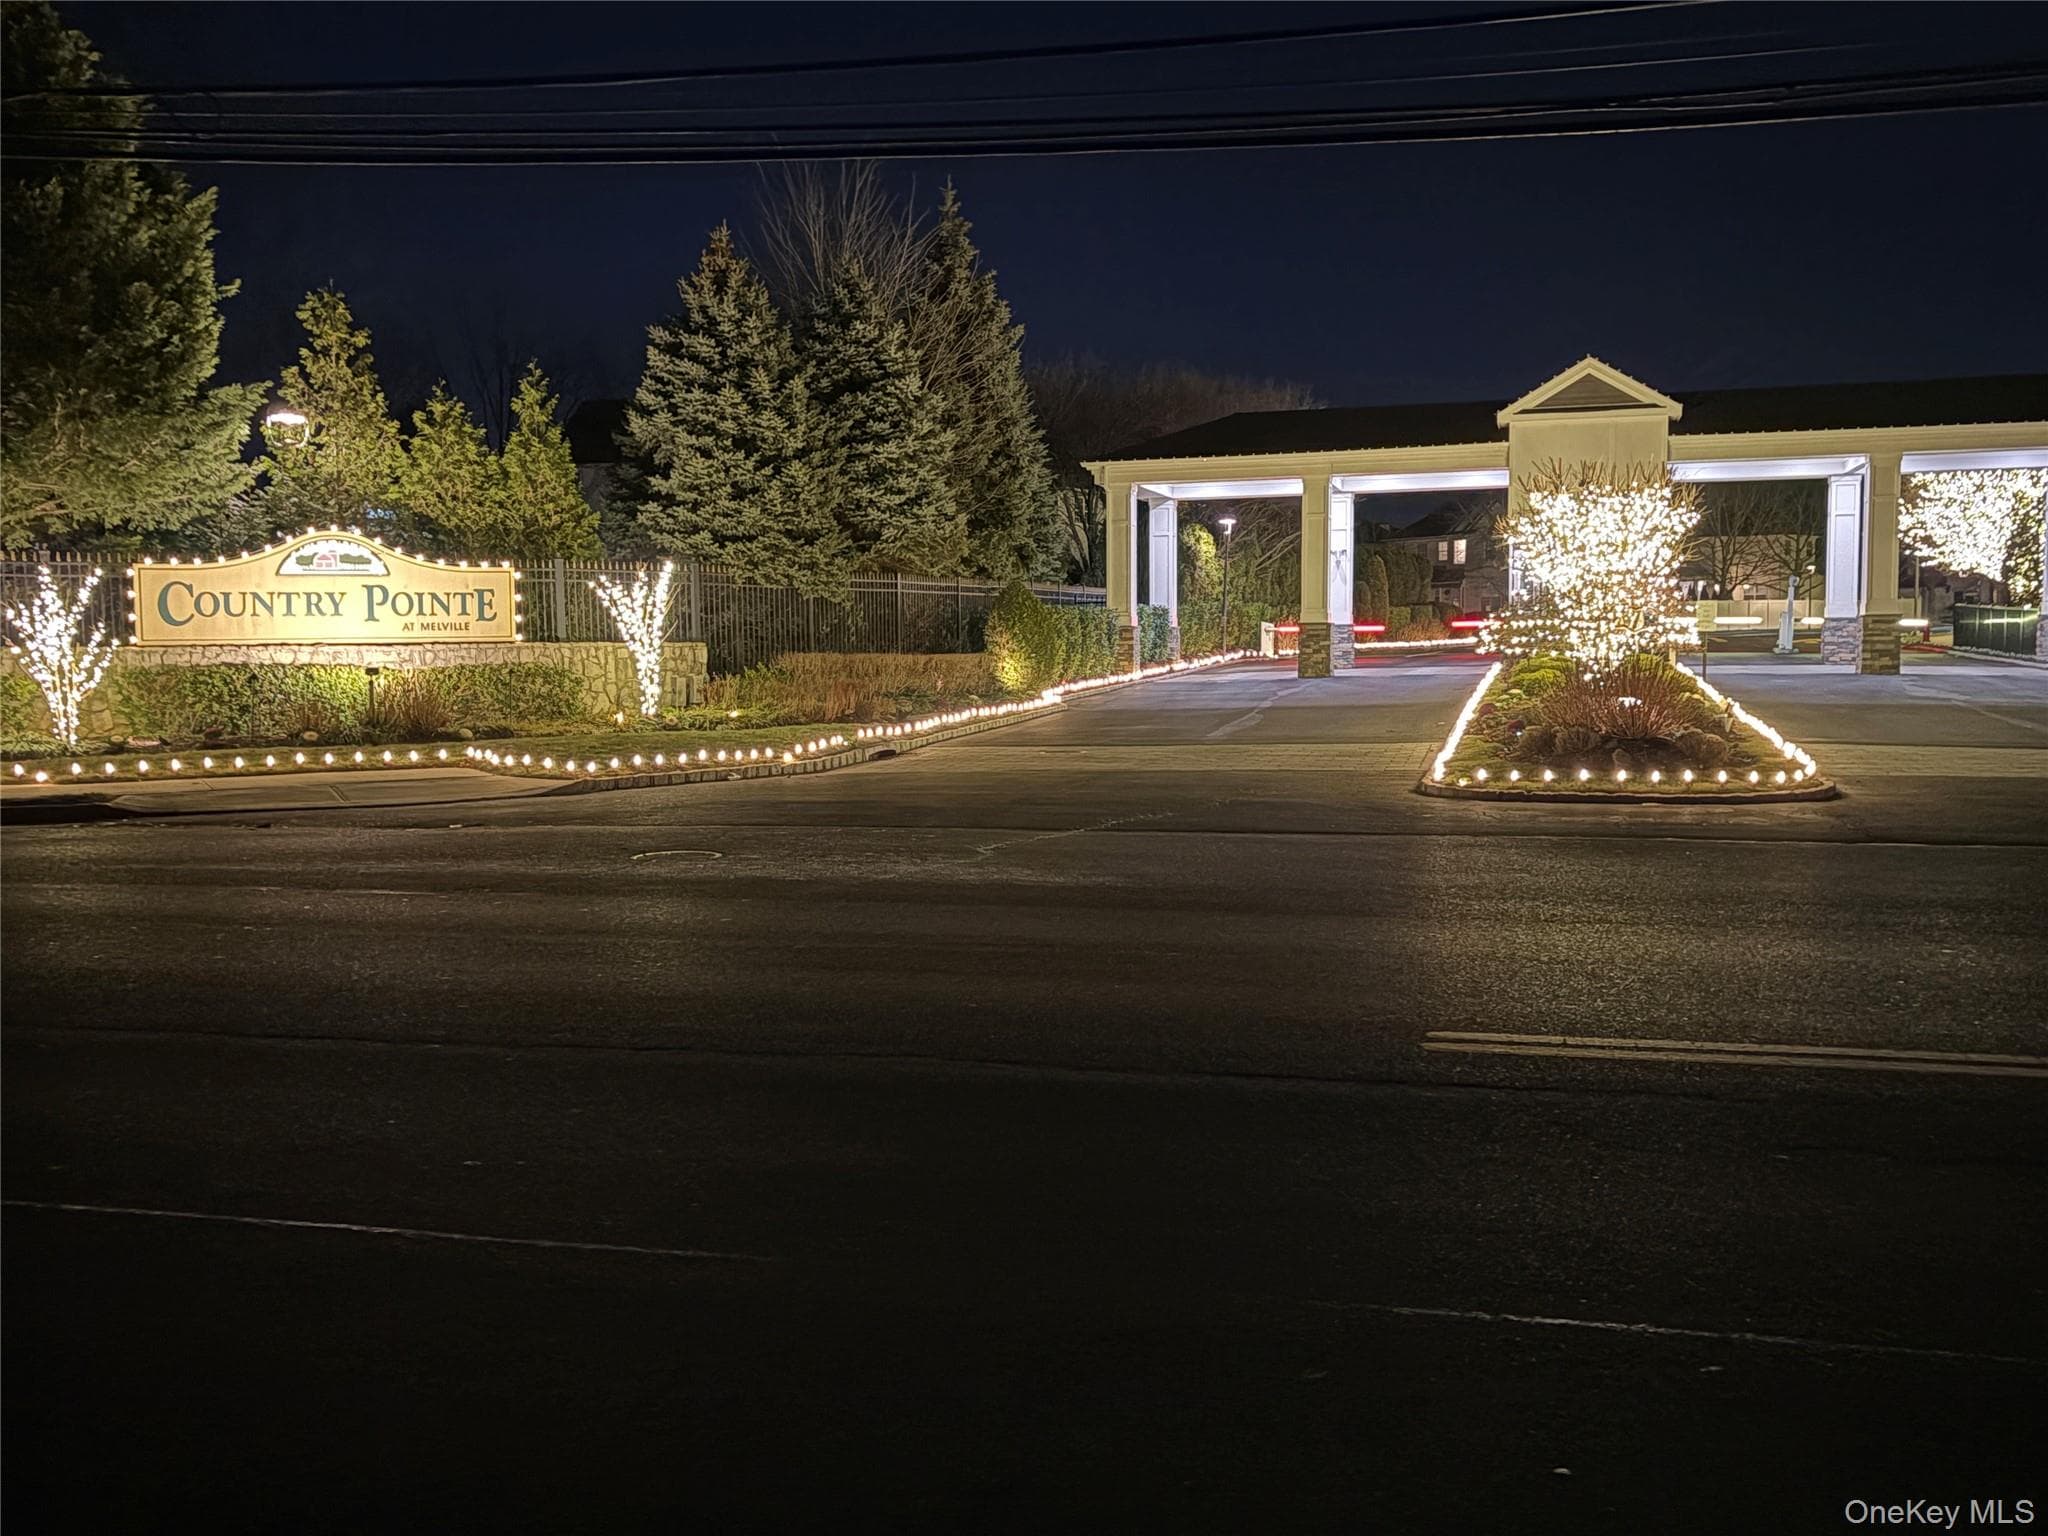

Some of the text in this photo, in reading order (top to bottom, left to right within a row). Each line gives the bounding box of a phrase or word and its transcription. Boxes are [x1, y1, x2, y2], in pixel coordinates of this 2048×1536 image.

[157, 581, 498, 627] COUNTRY POINTE
[402, 622, 471, 632] AT MELVILLE
